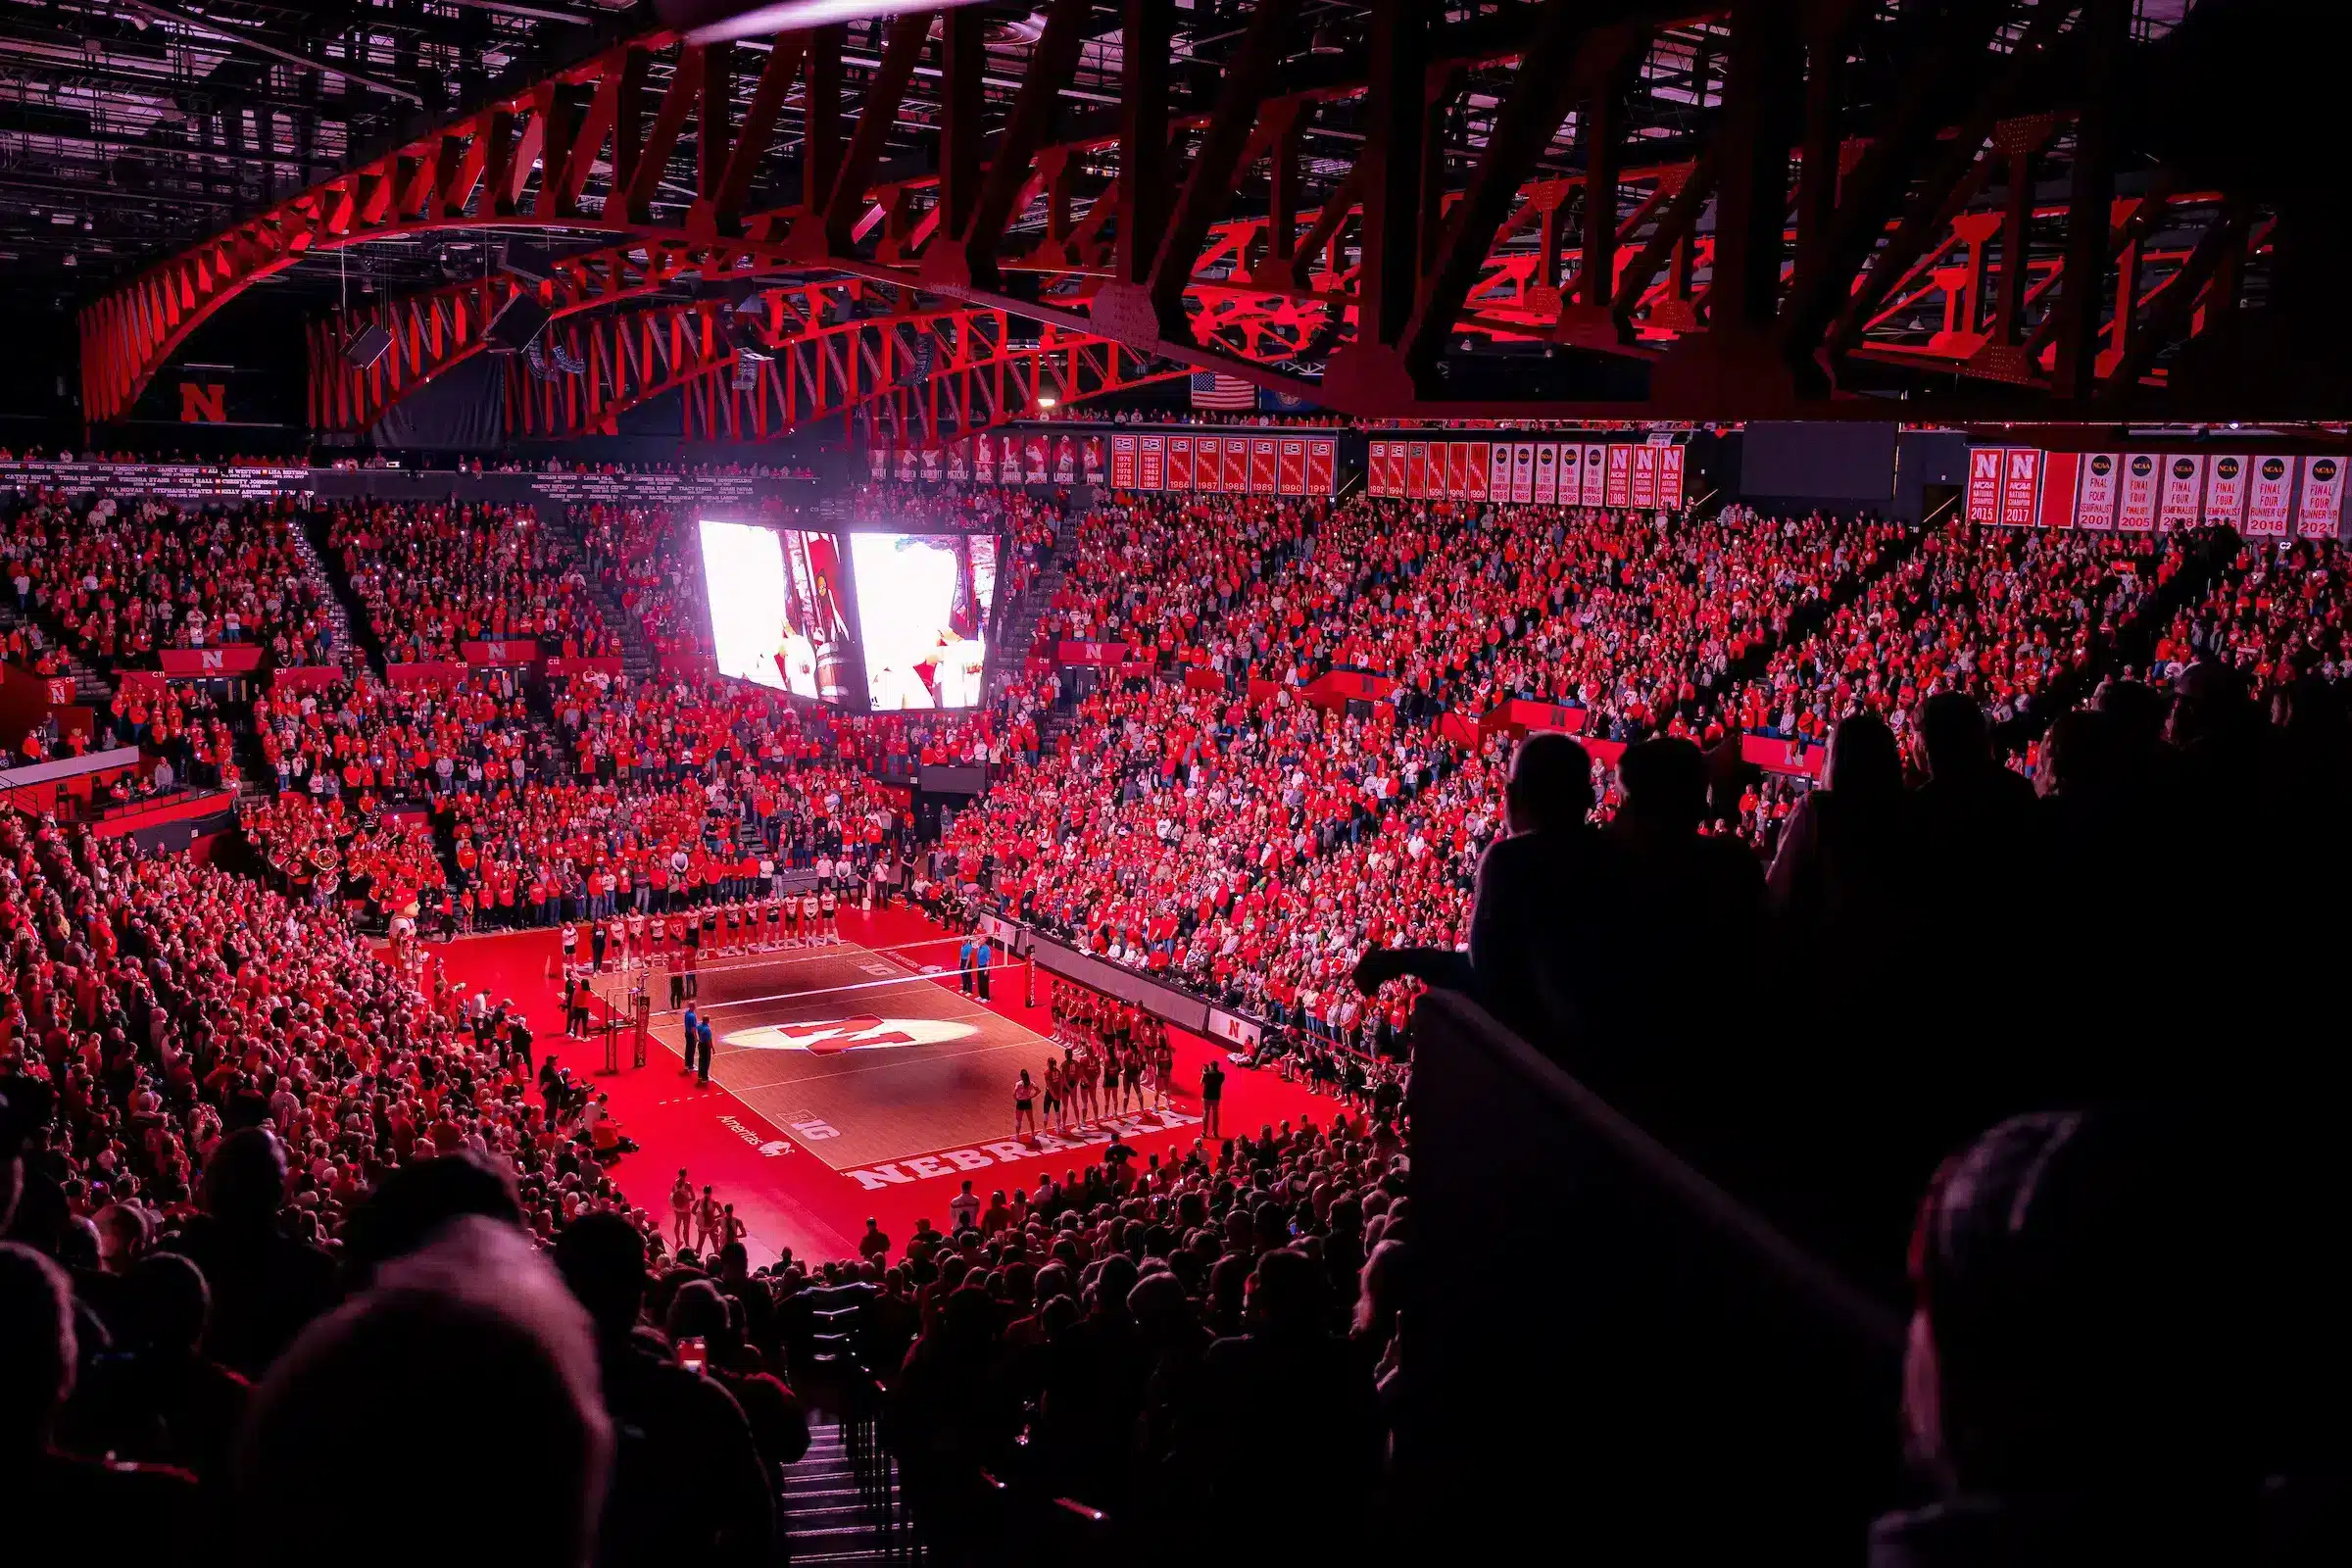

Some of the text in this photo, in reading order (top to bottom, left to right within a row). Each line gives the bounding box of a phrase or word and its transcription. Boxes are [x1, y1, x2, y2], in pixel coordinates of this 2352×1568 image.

[180, 383, 226, 422] N
[1611, 449, 1628, 469] N
[1638, 450, 1653, 470] N
[1663, 450, 1681, 470] N
[1975, 454, 1998, 478] N
[2010, 454, 2034, 479] N
[2089, 478, 2107, 488] FINAL
[2130, 480, 2148, 490] FINAL
[2171, 482, 2190, 492] FINAL
[2216, 483, 2235, 493] FINAL
[2259, 483, 2280, 494] FINAL
[2310, 484, 2332, 496] FINAL
[1609, 493, 1626, 505] 1995
[1635, 494, 1650, 506] 2000
[2088, 491, 2105, 502] FOUR
[2130, 493, 2145, 503] FOUR
[2171, 494, 2188, 504] FOUR
[2216, 496, 2232, 506] FOUR
[2259, 496, 2278, 507] FOUR
[2080, 503, 2112, 513] SEMIFINALIST
[2310, 498, 2329, 509] FOUR
[1971, 507, 1993, 520] 2015
[2006, 508, 2029, 522] 2017
[2082, 515, 2109, 524] 2001
[2121, 517, 2150, 527] 2005
[2250, 520, 2283, 530] 2018
[2299, 522, 2335, 533] 2021
[488, 643, 505, 659] N
[1086, 644, 1102, 659] N
[202, 651, 222, 667] N
[1229, 1019, 1240, 1039] N
[716, 1114, 763, 1146] Ameritas
[840, 1109, 1203, 1191] NEBRASKA
